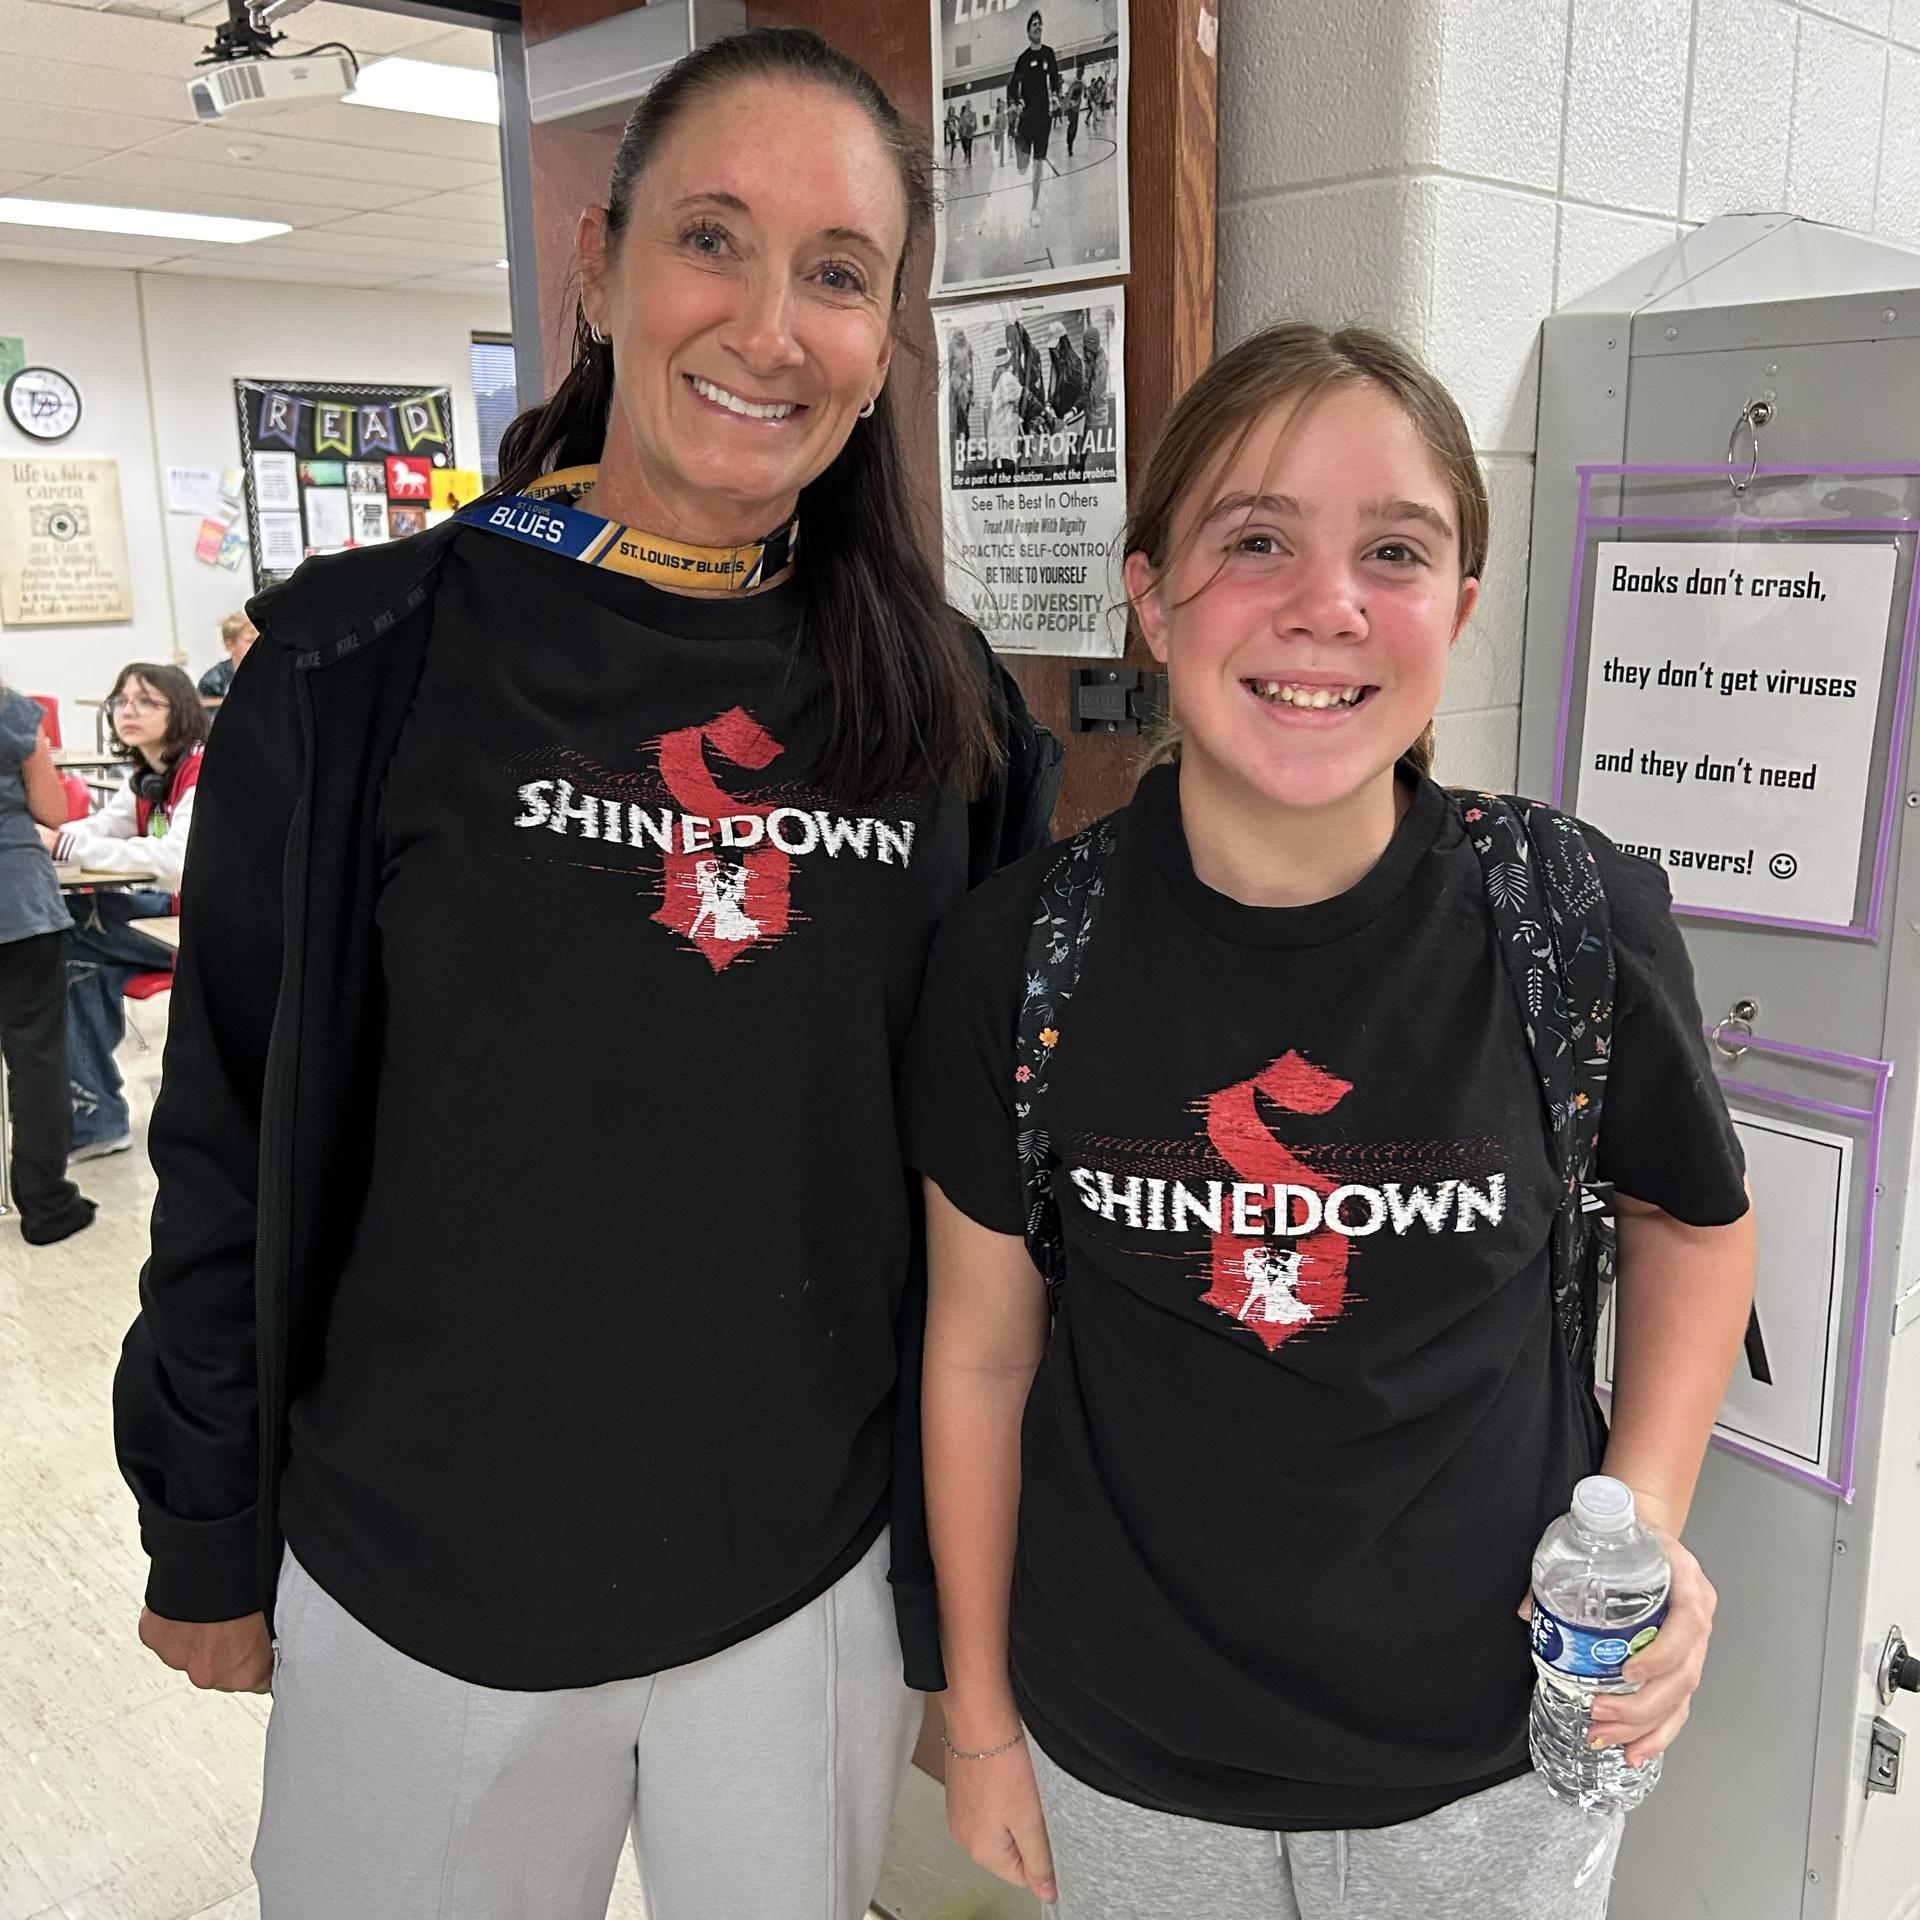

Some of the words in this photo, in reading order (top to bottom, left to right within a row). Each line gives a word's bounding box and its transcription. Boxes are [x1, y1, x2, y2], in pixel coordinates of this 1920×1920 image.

[269, 399, 428, 439] READ
[955, 434, 1034, 462] RESPECT
[1039, 432, 1077, 457] FOR
[1082, 428, 1115, 453] ALL
[1053, 470, 1066, 480] not
[1068, 469, 1081, 480] the
[972, 496, 993, 511] See
[996, 494, 1014, 510] The
[1018, 493, 1041, 509] Best
[1045, 493, 1055, 508] In
[1059, 490, 1098, 508] Others
[489, 506, 565, 543] BLUES
[983, 519, 1002, 534] Treat
[1003, 518, 1014, 534] All
[1015, 518, 1039, 536] People
[1040, 517, 1058, 533] With
[1059, 517, 1087, 536] Dignity
[620, 541, 638, 559] ST.
[639, 547, 680, 568] LOUIS
[962, 544, 1015, 558] PRACTICE
[1020, 543, 1111, 558] SELF-CONTROL
[986, 567, 998, 584] BE
[1001, 567, 1023, 584] TRUE
[1025, 567, 1037, 584] TO
[1039, 567, 1087, 584] YOURSELF
[1612, 565, 1679, 594] Books
[1685, 567, 1744, 596] don't
[1750, 571, 1827, 601] crash,
[1022, 594, 1103, 612] DIVERSITY
[1037, 613, 1096, 632] PEOPLE
[1603, 656, 1651, 690] they
[1657, 659, 1714, 689] don't
[1720, 669, 1758, 696] get
[1766, 669, 1857, 698] viruses
[1594, 747, 1635, 774] and
[1640, 749, 1689, 784] they
[1694, 754, 1753, 785] don't
[1759, 763, 1817, 790] need
[514, 778, 916, 869] SHINEDOWN
[1668, 849, 1754, 875] savers!
[1070, 1166, 1507, 1237] SHINEDOWN
